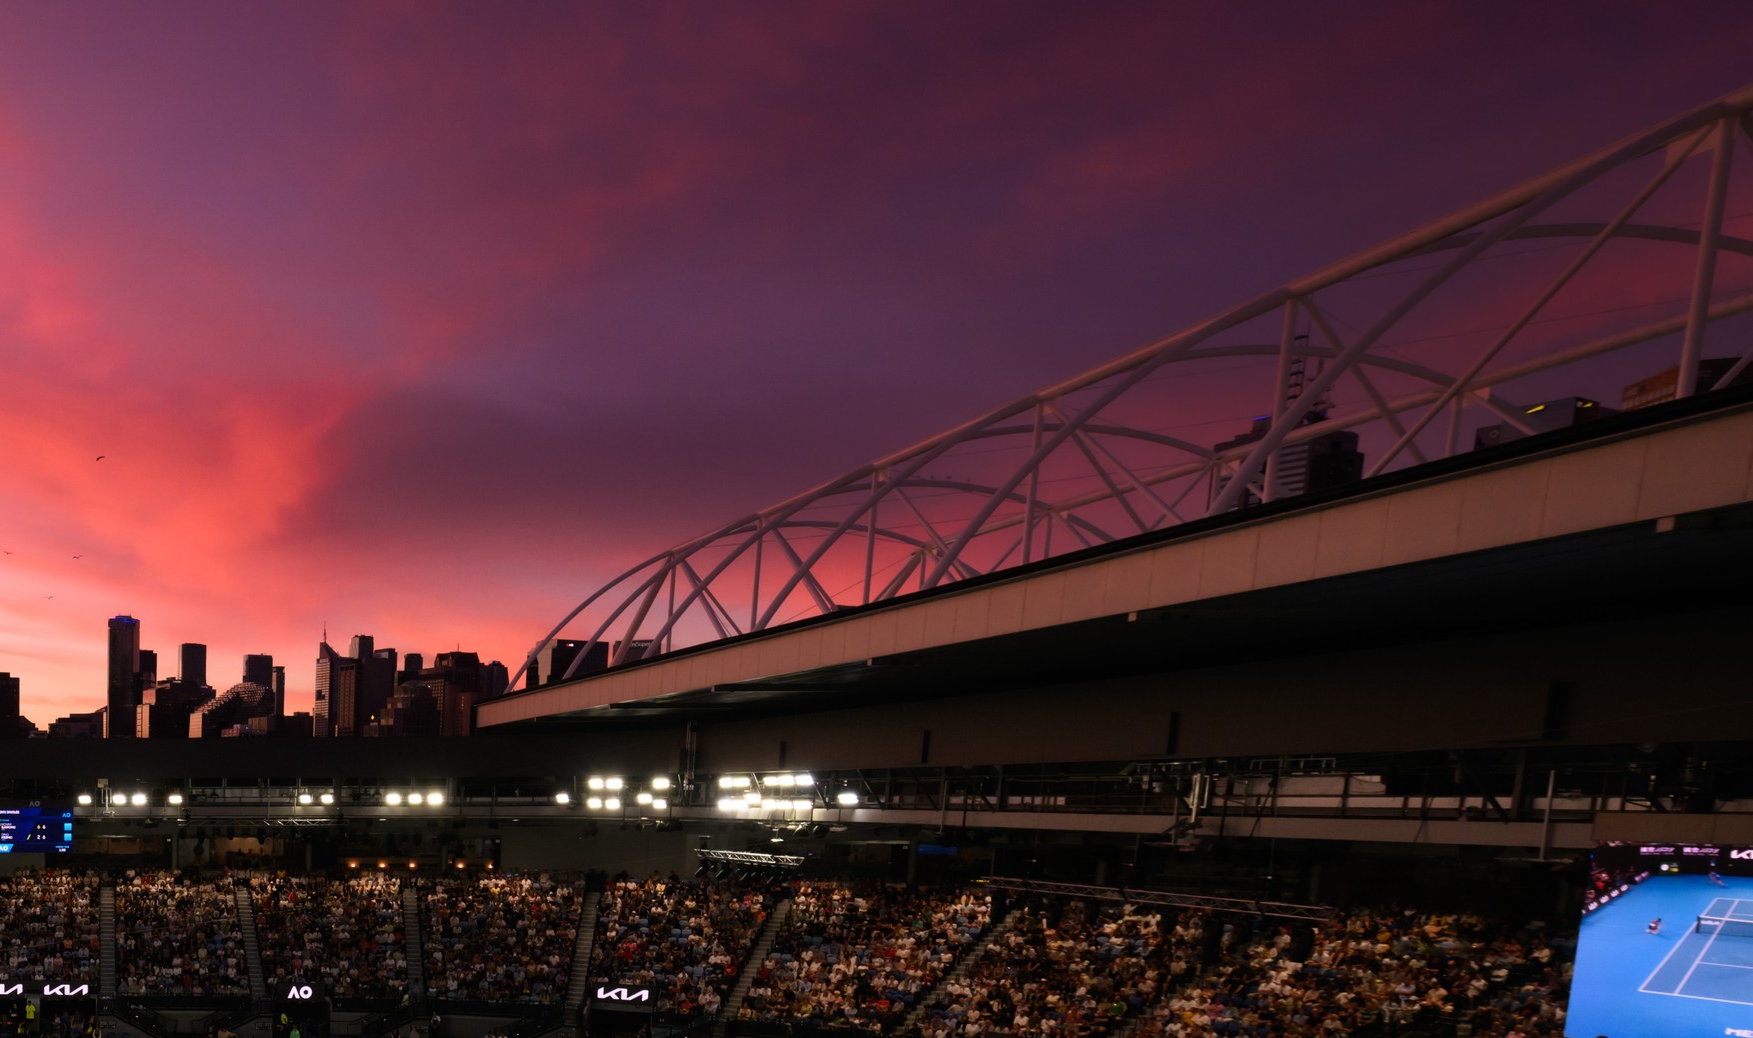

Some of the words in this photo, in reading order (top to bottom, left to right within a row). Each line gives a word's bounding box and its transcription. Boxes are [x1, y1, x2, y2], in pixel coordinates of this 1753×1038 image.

[44, 985, 89, 996] KIA
[288, 985, 313, 999] AO
[597, 986, 649, 1002] KIA
